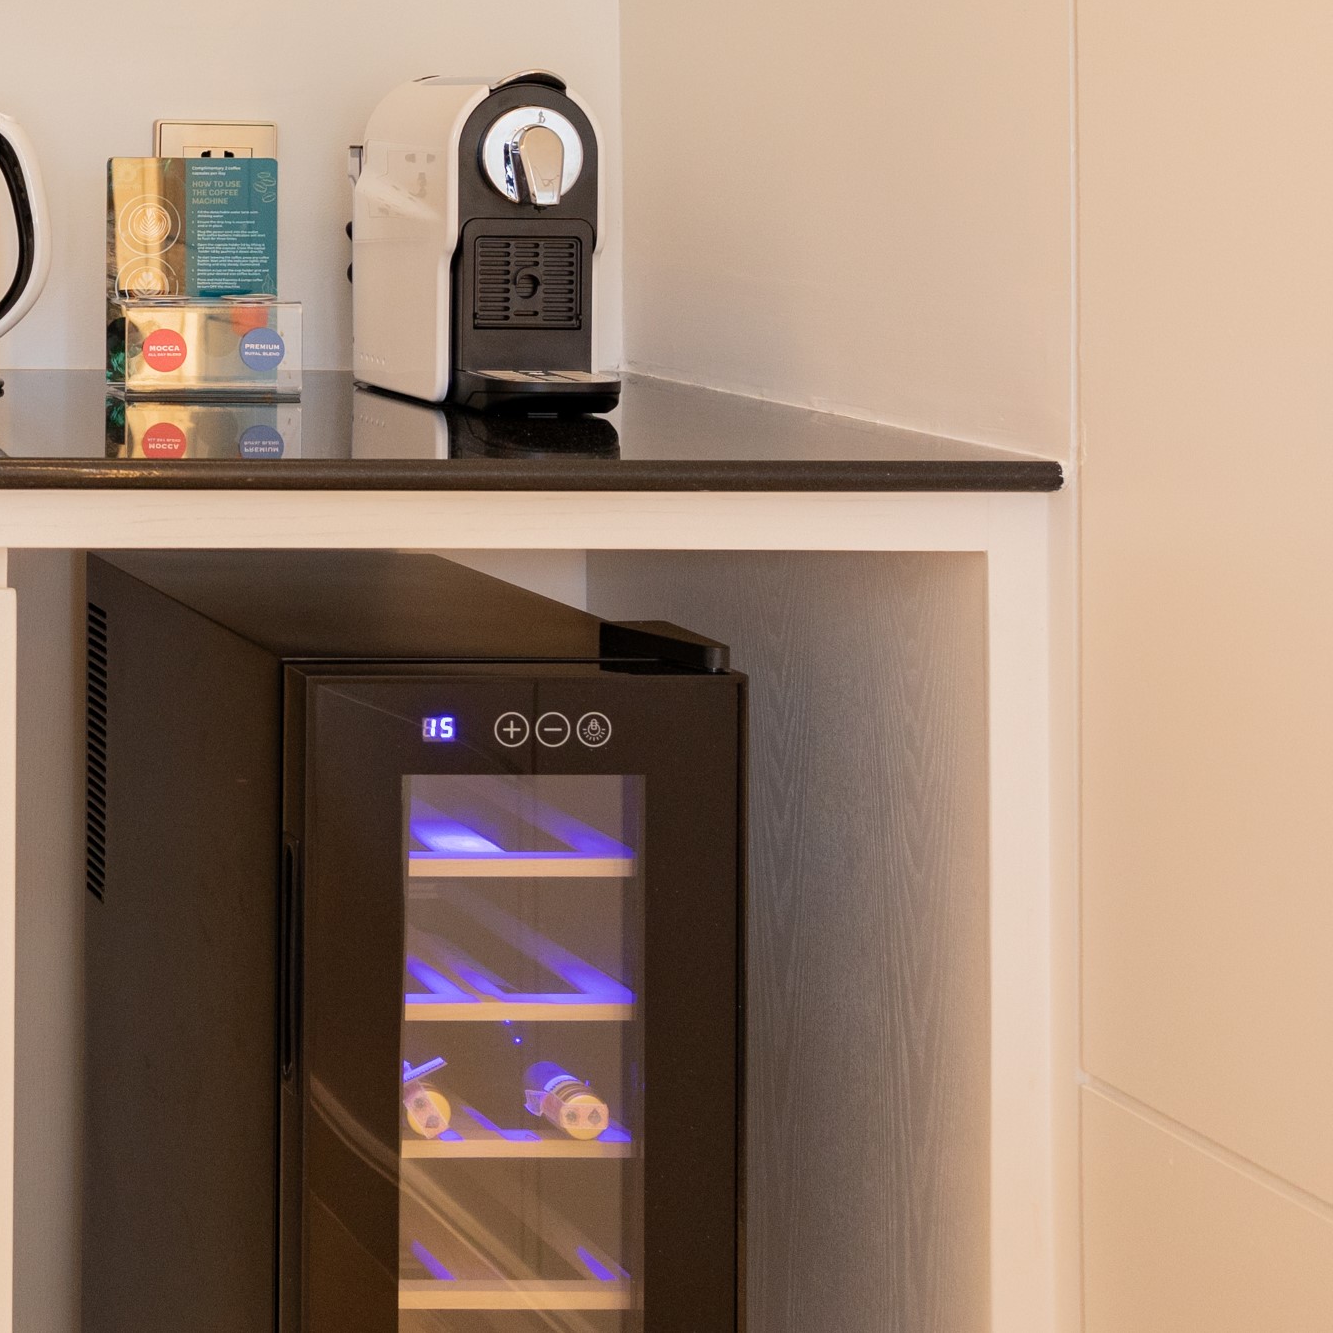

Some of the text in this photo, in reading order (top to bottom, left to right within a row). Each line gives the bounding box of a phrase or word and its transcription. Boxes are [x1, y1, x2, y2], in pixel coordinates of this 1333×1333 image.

[192, 180, 241, 188] HOW TO USE
[208, 189, 238, 197] COFFEE
[192, 197, 229, 205] MACHINE
[429, 717, 453, 738] 15
